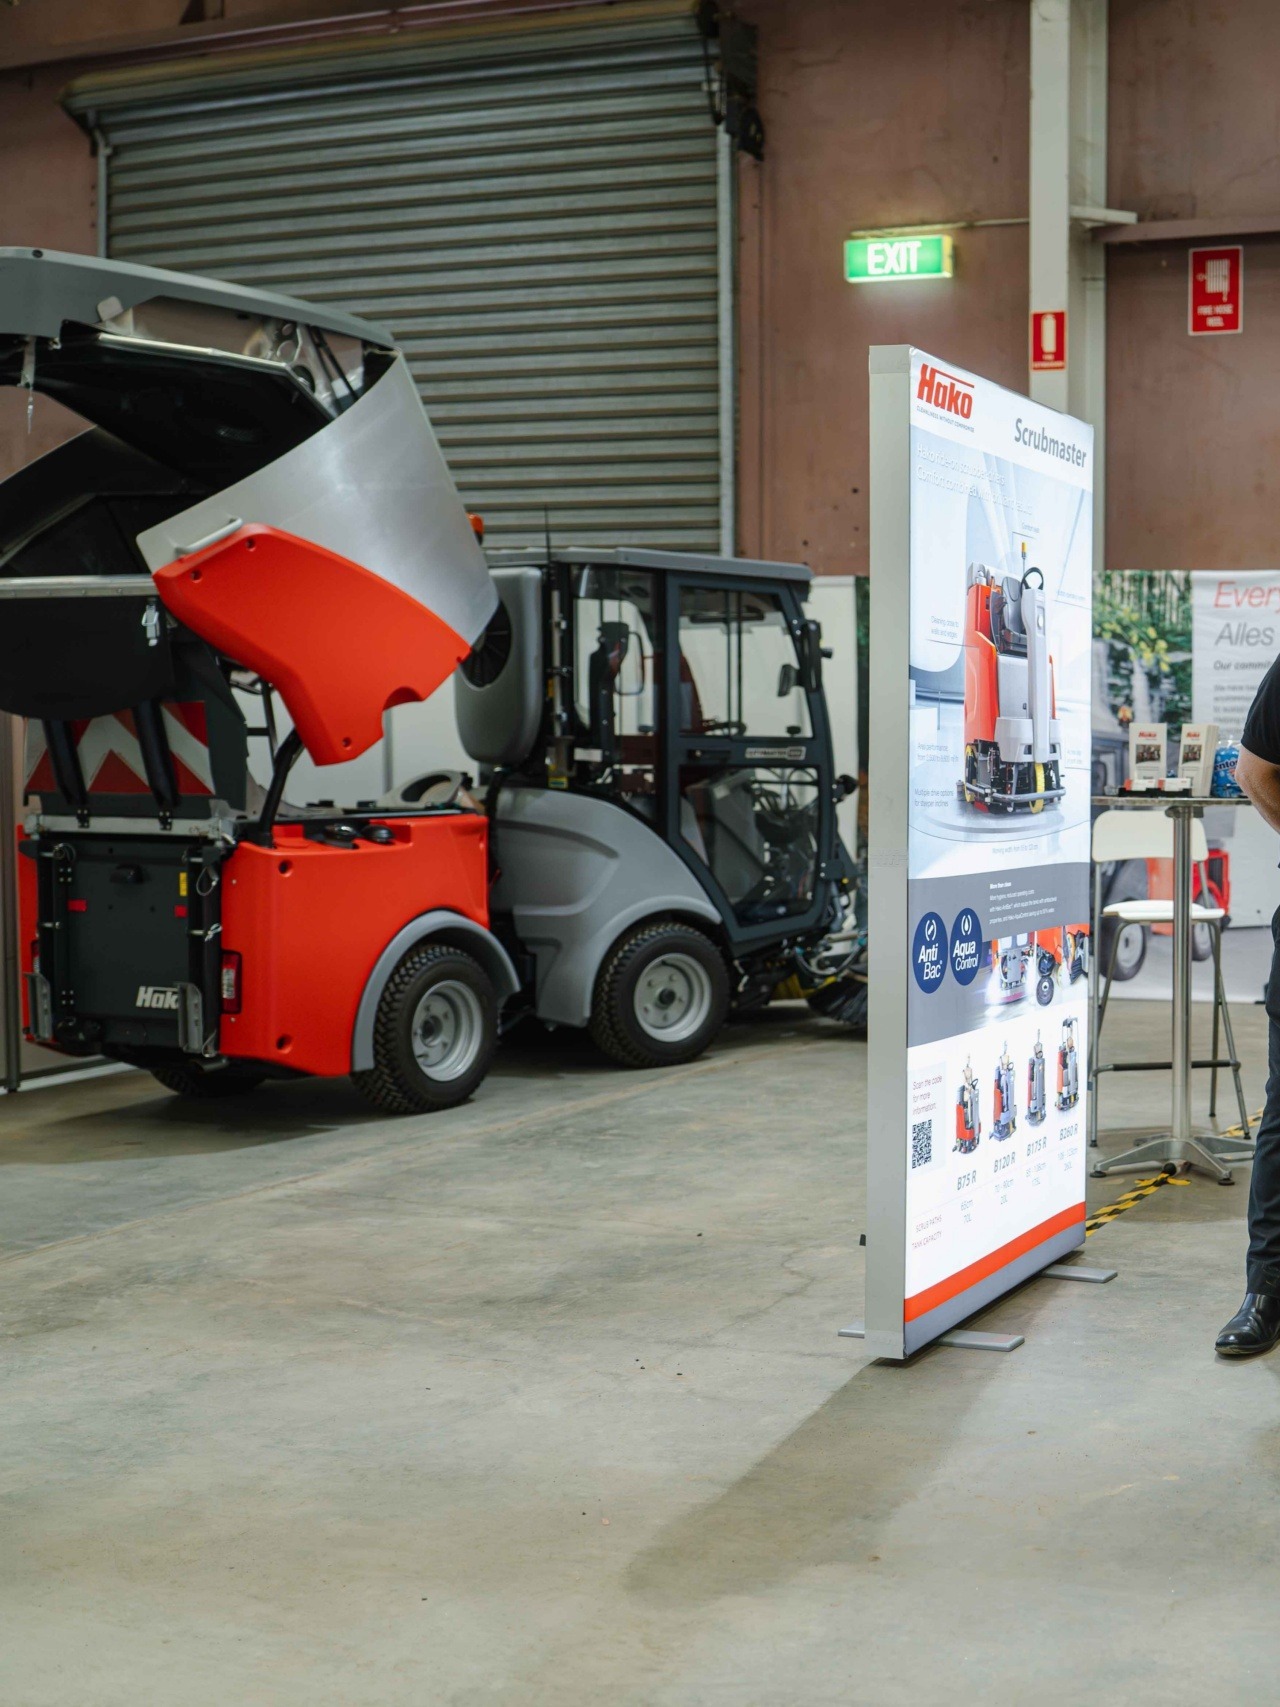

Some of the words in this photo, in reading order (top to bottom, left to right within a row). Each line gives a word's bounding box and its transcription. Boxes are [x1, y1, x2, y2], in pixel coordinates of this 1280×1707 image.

[867, 240, 922, 275] EXIT
[917, 363, 975, 419] Hako
[1014, 417, 1087, 468] Scrubmaster
[1214, 621, 1275, 647] Alles
[1214, 759, 1238, 771] entos
[918, 943, 939, 964] Anti
[953, 940, 976, 959] Aqua
[955, 954, 978, 972] Control
[136, 985, 180, 1010] Hak
[1027, 1138, 1042, 1157] B175
[1042, 1136, 1047, 1149] R
[993, 1153, 1010, 1174] B120
[1010, 1151, 1016, 1165] R
[957, 1173, 971, 1191] B75
[971, 1169, 977, 1184] R
